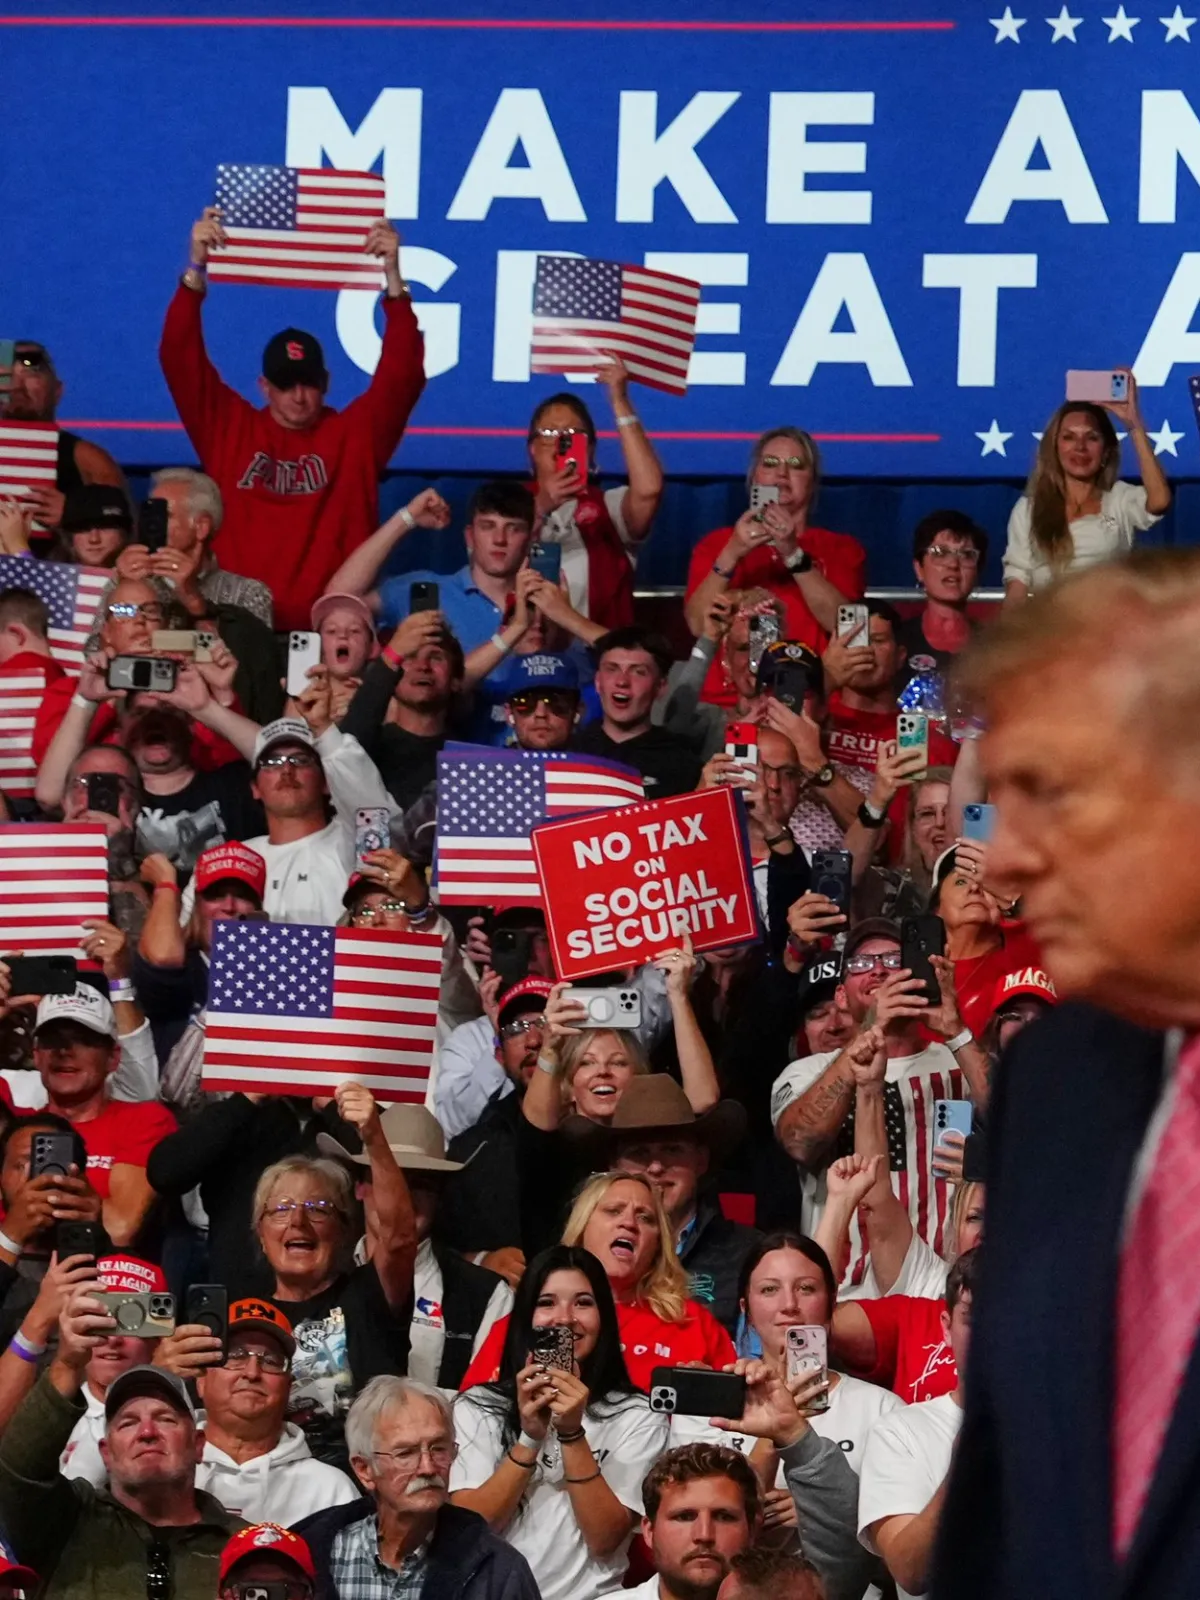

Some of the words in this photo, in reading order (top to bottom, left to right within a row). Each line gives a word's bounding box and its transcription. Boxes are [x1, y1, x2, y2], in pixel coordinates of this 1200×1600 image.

[286, 87, 874, 224] MAKE
[521, 654, 565, 669] AMERICA
[527, 665, 556, 677] FIRST
[829, 731, 878, 752] TRU
[572, 831, 632, 869] NO
[637, 813, 708, 852] TAX
[633, 856, 666, 878] ON
[584, 869, 718, 923] SOCIAL
[565, 903, 738, 959] SECURITY
[808, 961, 842, 984] US
[1003, 966, 1058, 1000] MAGA
[96, 1260, 114, 1276] AKE
[114, 1260, 157, 1283] AMERICA
[96, 1274, 119, 1287] EAT
[119, 1275, 152, 1293] AGAIN
